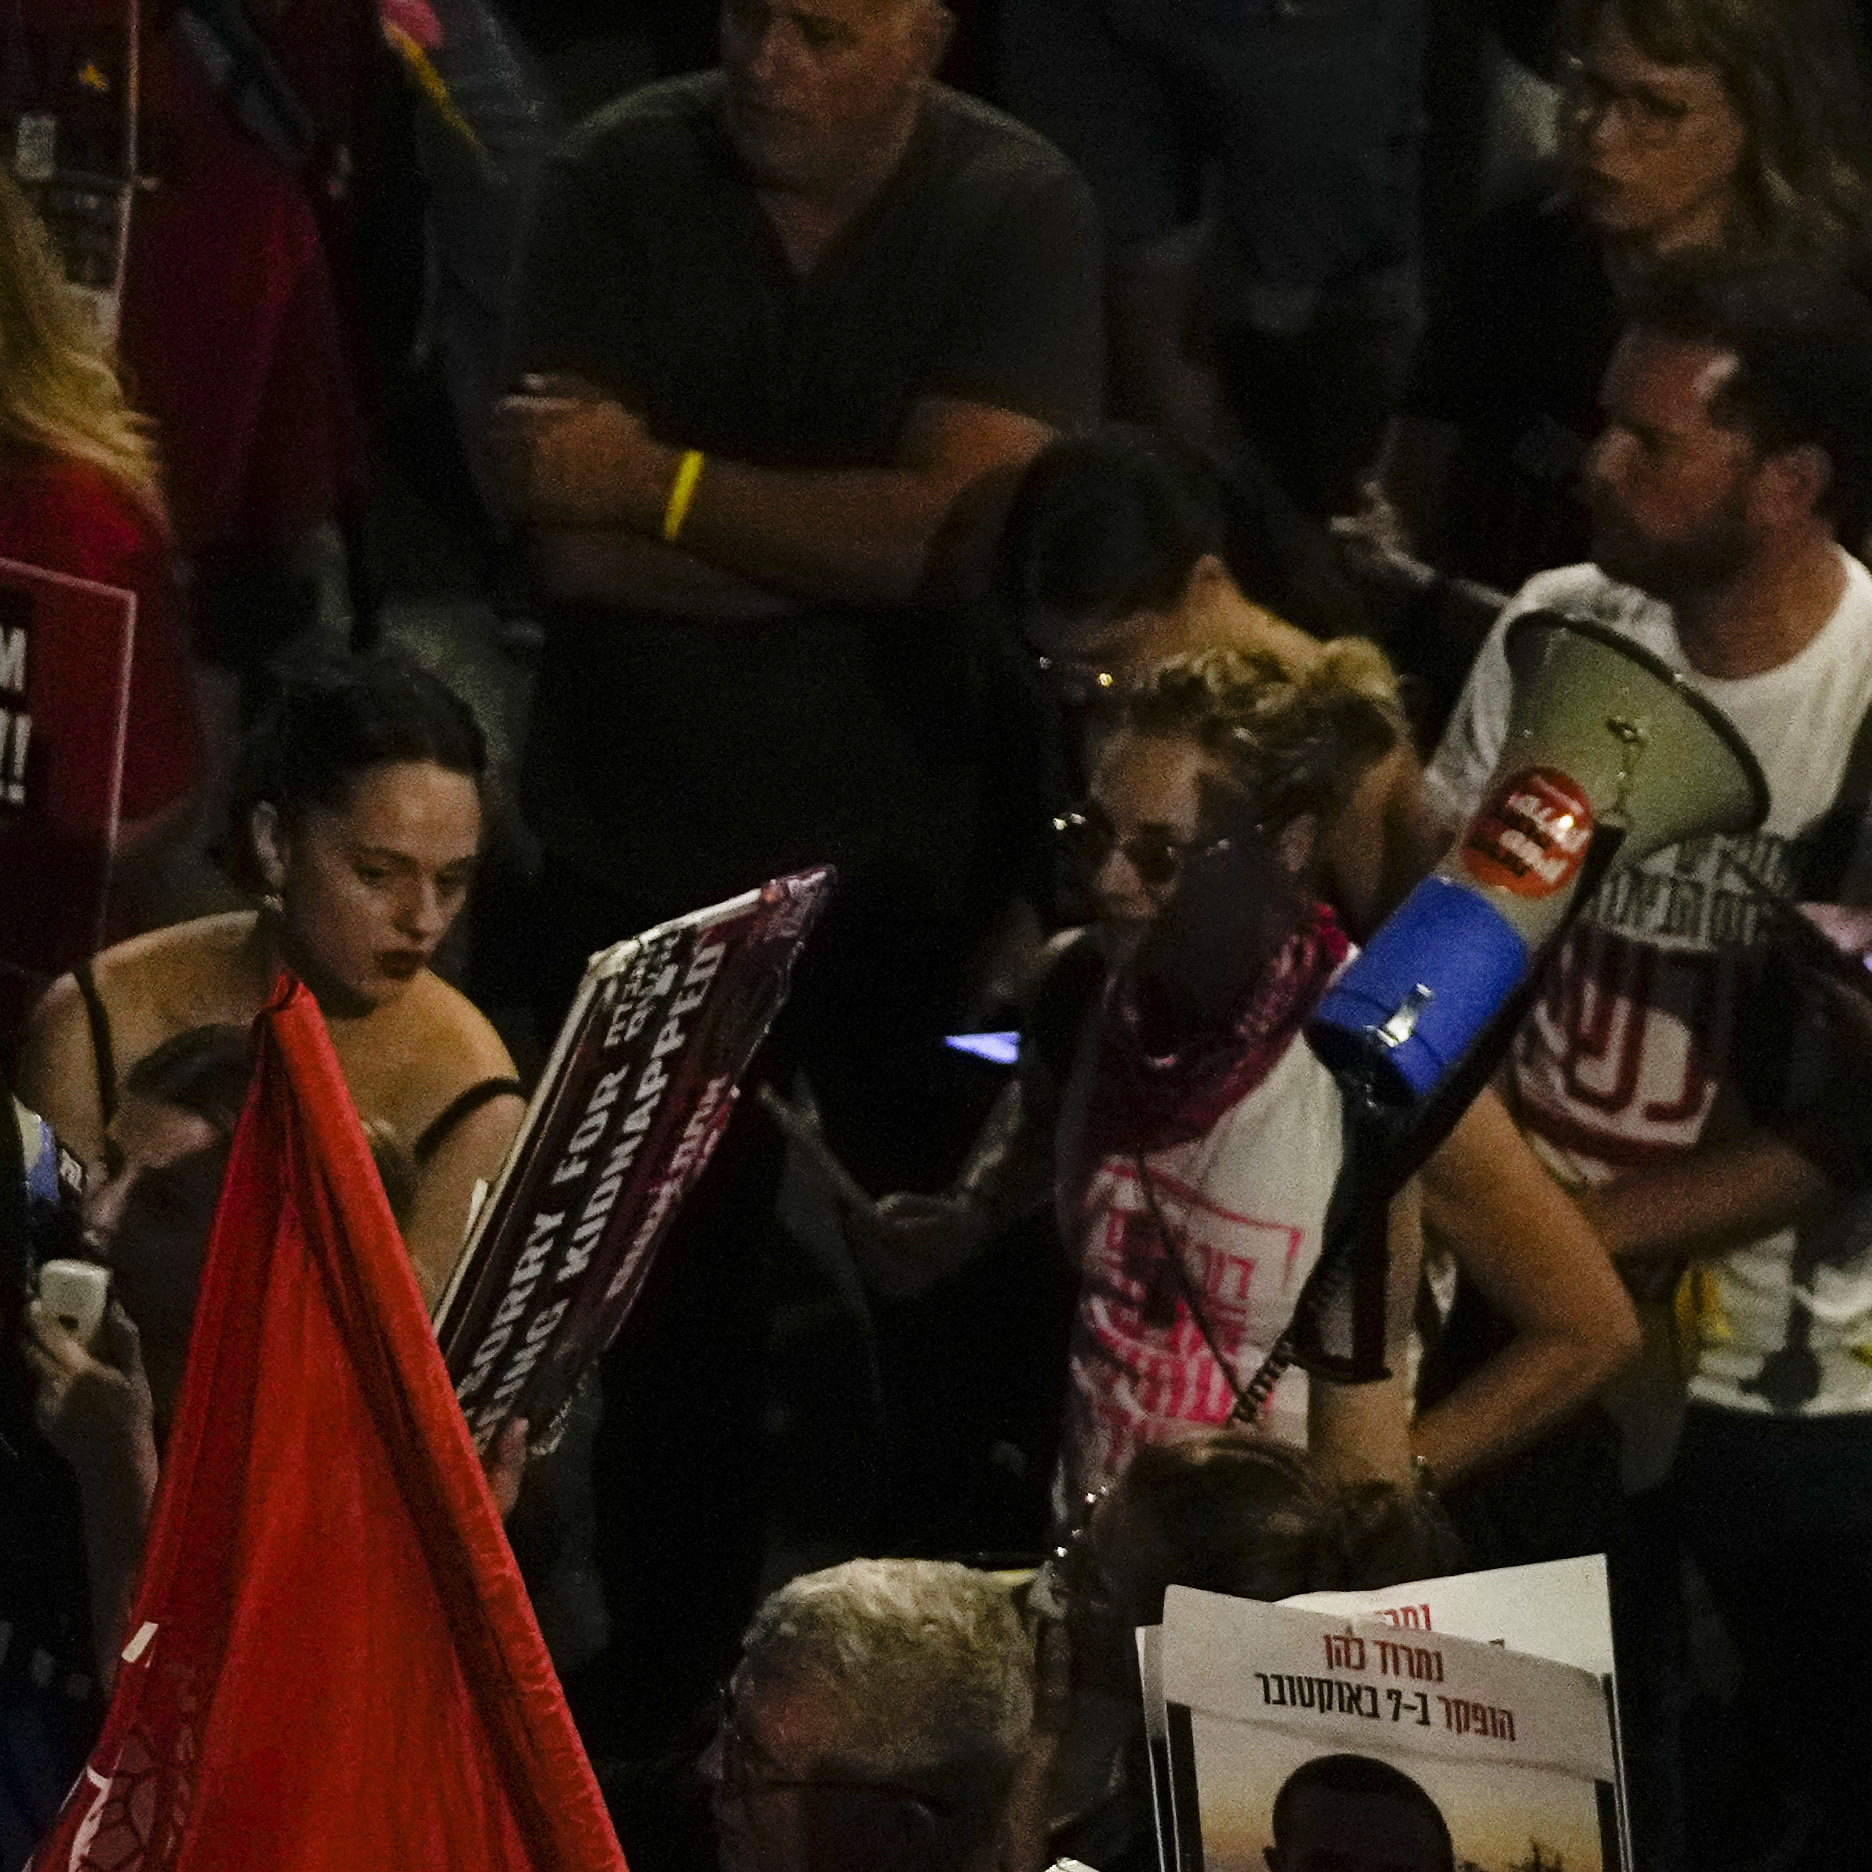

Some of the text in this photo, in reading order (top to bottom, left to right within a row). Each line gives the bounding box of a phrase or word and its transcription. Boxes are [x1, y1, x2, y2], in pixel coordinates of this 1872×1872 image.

[557, 944, 727, 1283] KIDNAPPED
[456, 1065, 630, 1400] SORRY FOR
[1321, 1633, 1446, 1684] נמרוד כהן
[1254, 1671, 1380, 1720] באוקטובר
[1435, 1694, 1518, 1742] הופקר
